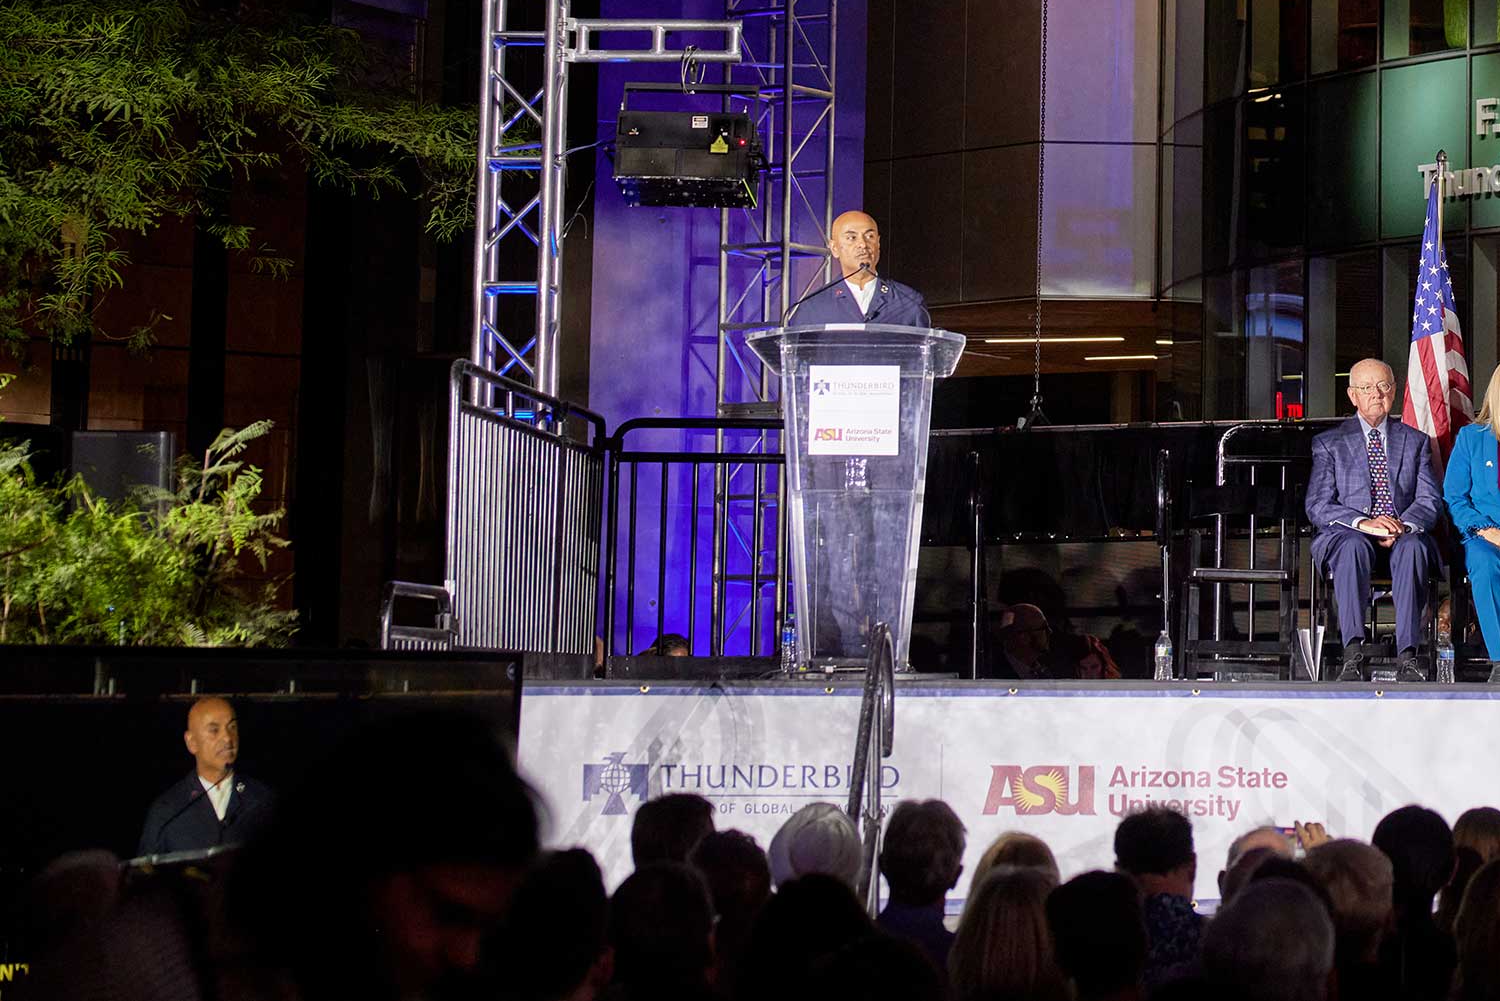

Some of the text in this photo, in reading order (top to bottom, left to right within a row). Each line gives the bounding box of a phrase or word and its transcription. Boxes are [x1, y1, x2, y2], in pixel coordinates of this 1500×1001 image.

[815, 428, 843, 441] ASU
[661, 764, 900, 788] THUNDERBID
[1109, 764, 1288, 789] Arizona State
[982, 765, 1097, 816] ASU
[719, 803, 736, 814] OF
